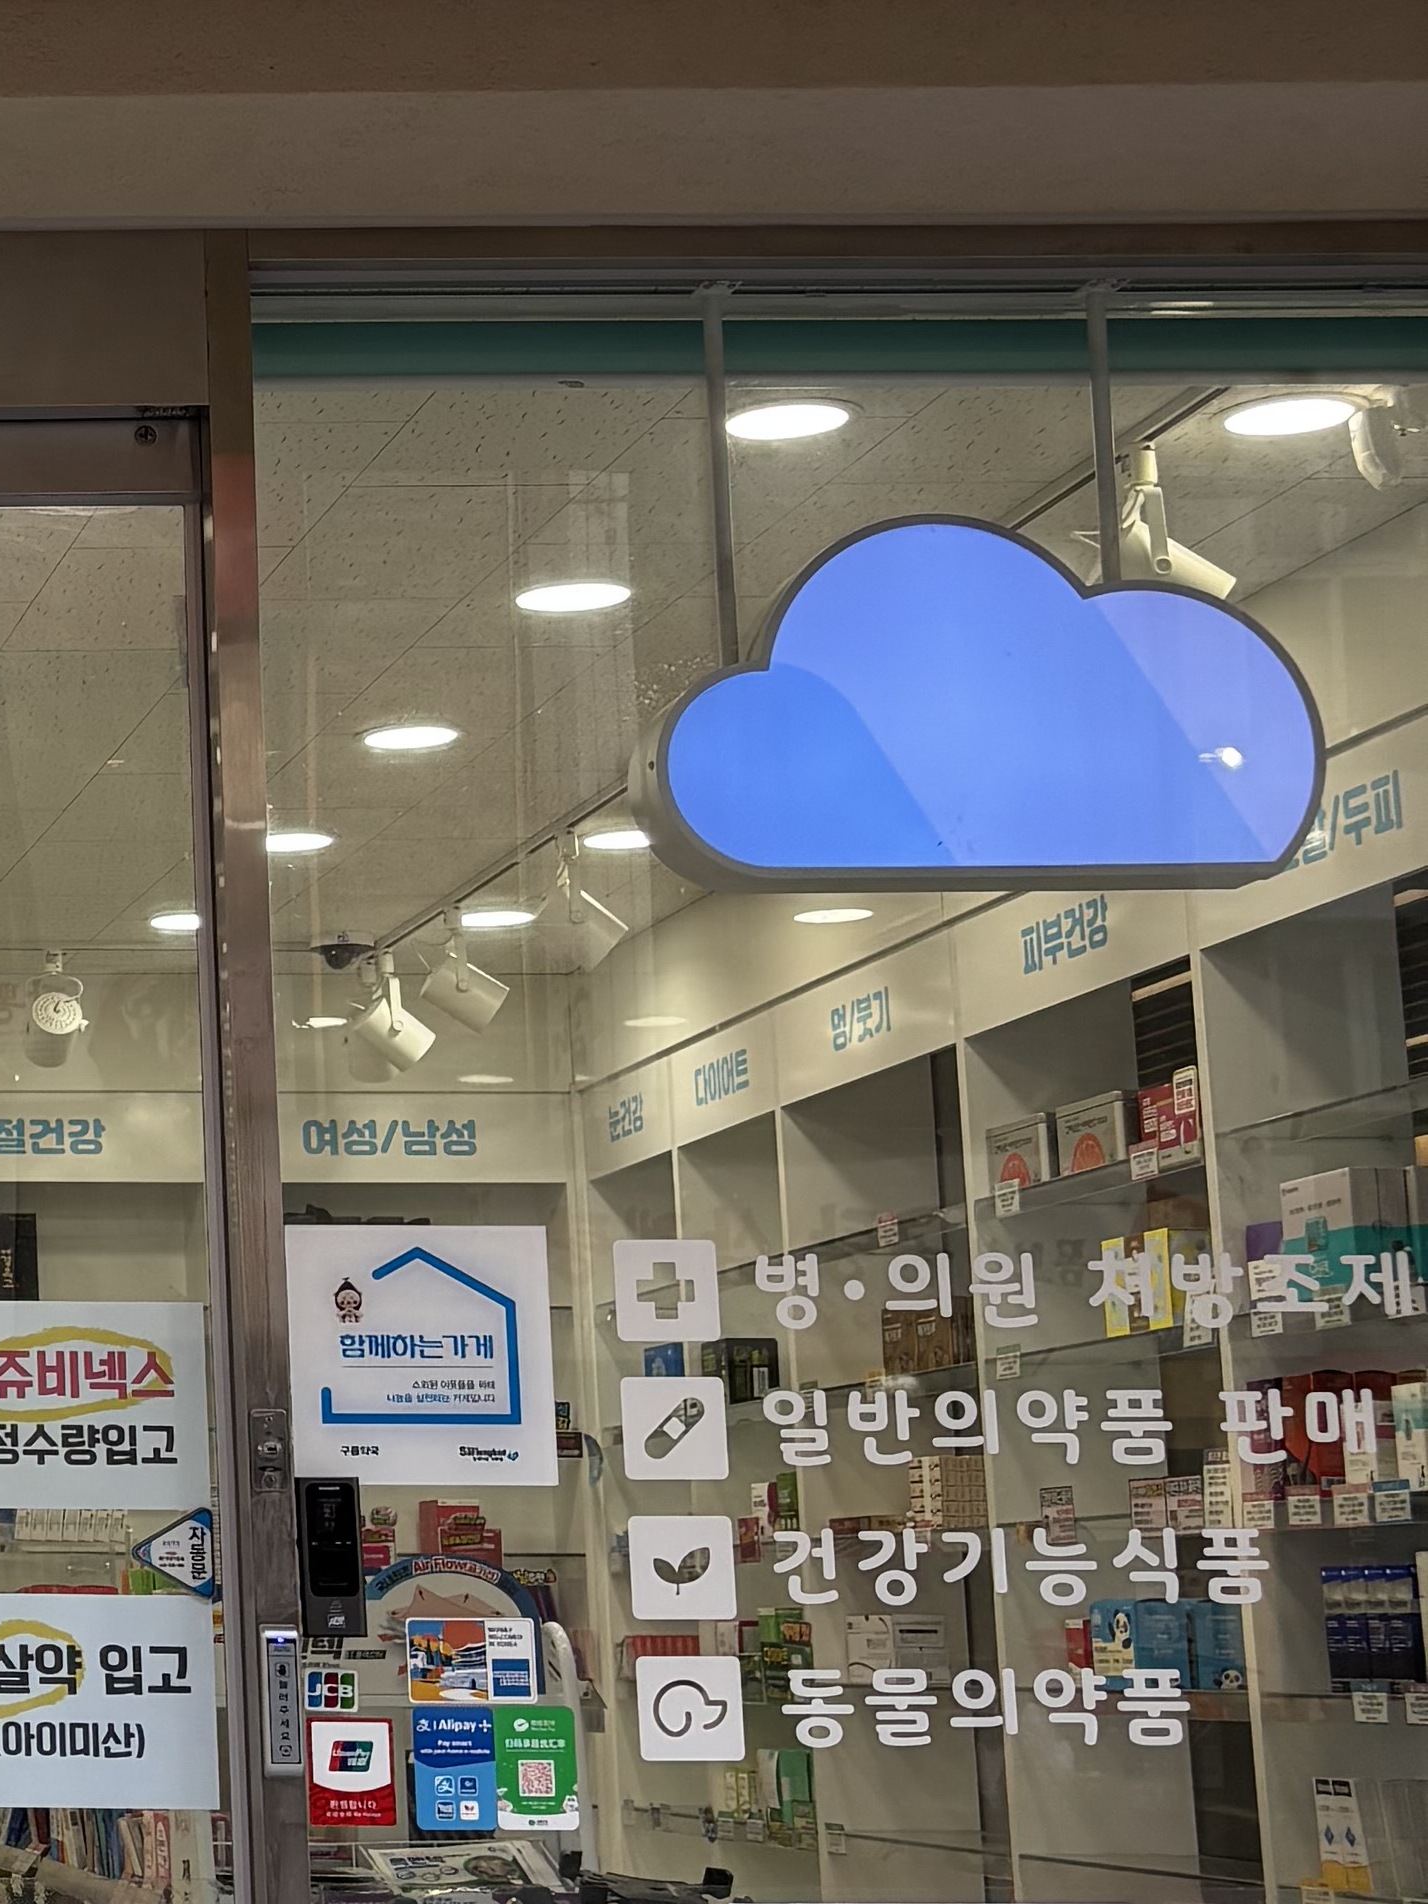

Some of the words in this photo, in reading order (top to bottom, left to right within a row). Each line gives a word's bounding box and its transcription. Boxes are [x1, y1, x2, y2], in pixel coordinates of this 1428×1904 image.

[1019, 893, 1110, 975] 피부건강
[830, 985, 892, 1052] 멍/붓기
[693, 1047, 750, 1108] 다이어트
[302, 1118, 478, 1157] 여성/남성
[606, 1091, 645, 1143] 눈건강
[1087, 1250, 1411, 1330] 처방조제
[338, 1333, 494, 1360] 함께하는가게
[761, 1387, 1174, 1467] 일반의약품
[1218, 1387, 1380, 1465] 판매
[771, 1526, 1273, 1607] 건강기능식품
[99, 1644, 193, 1696] 입고
[306, 1682, 355, 1698] JCB
[437, 1718, 476, 1733] Alipay
[779, 1666, 1191, 1749] 동물의약품
